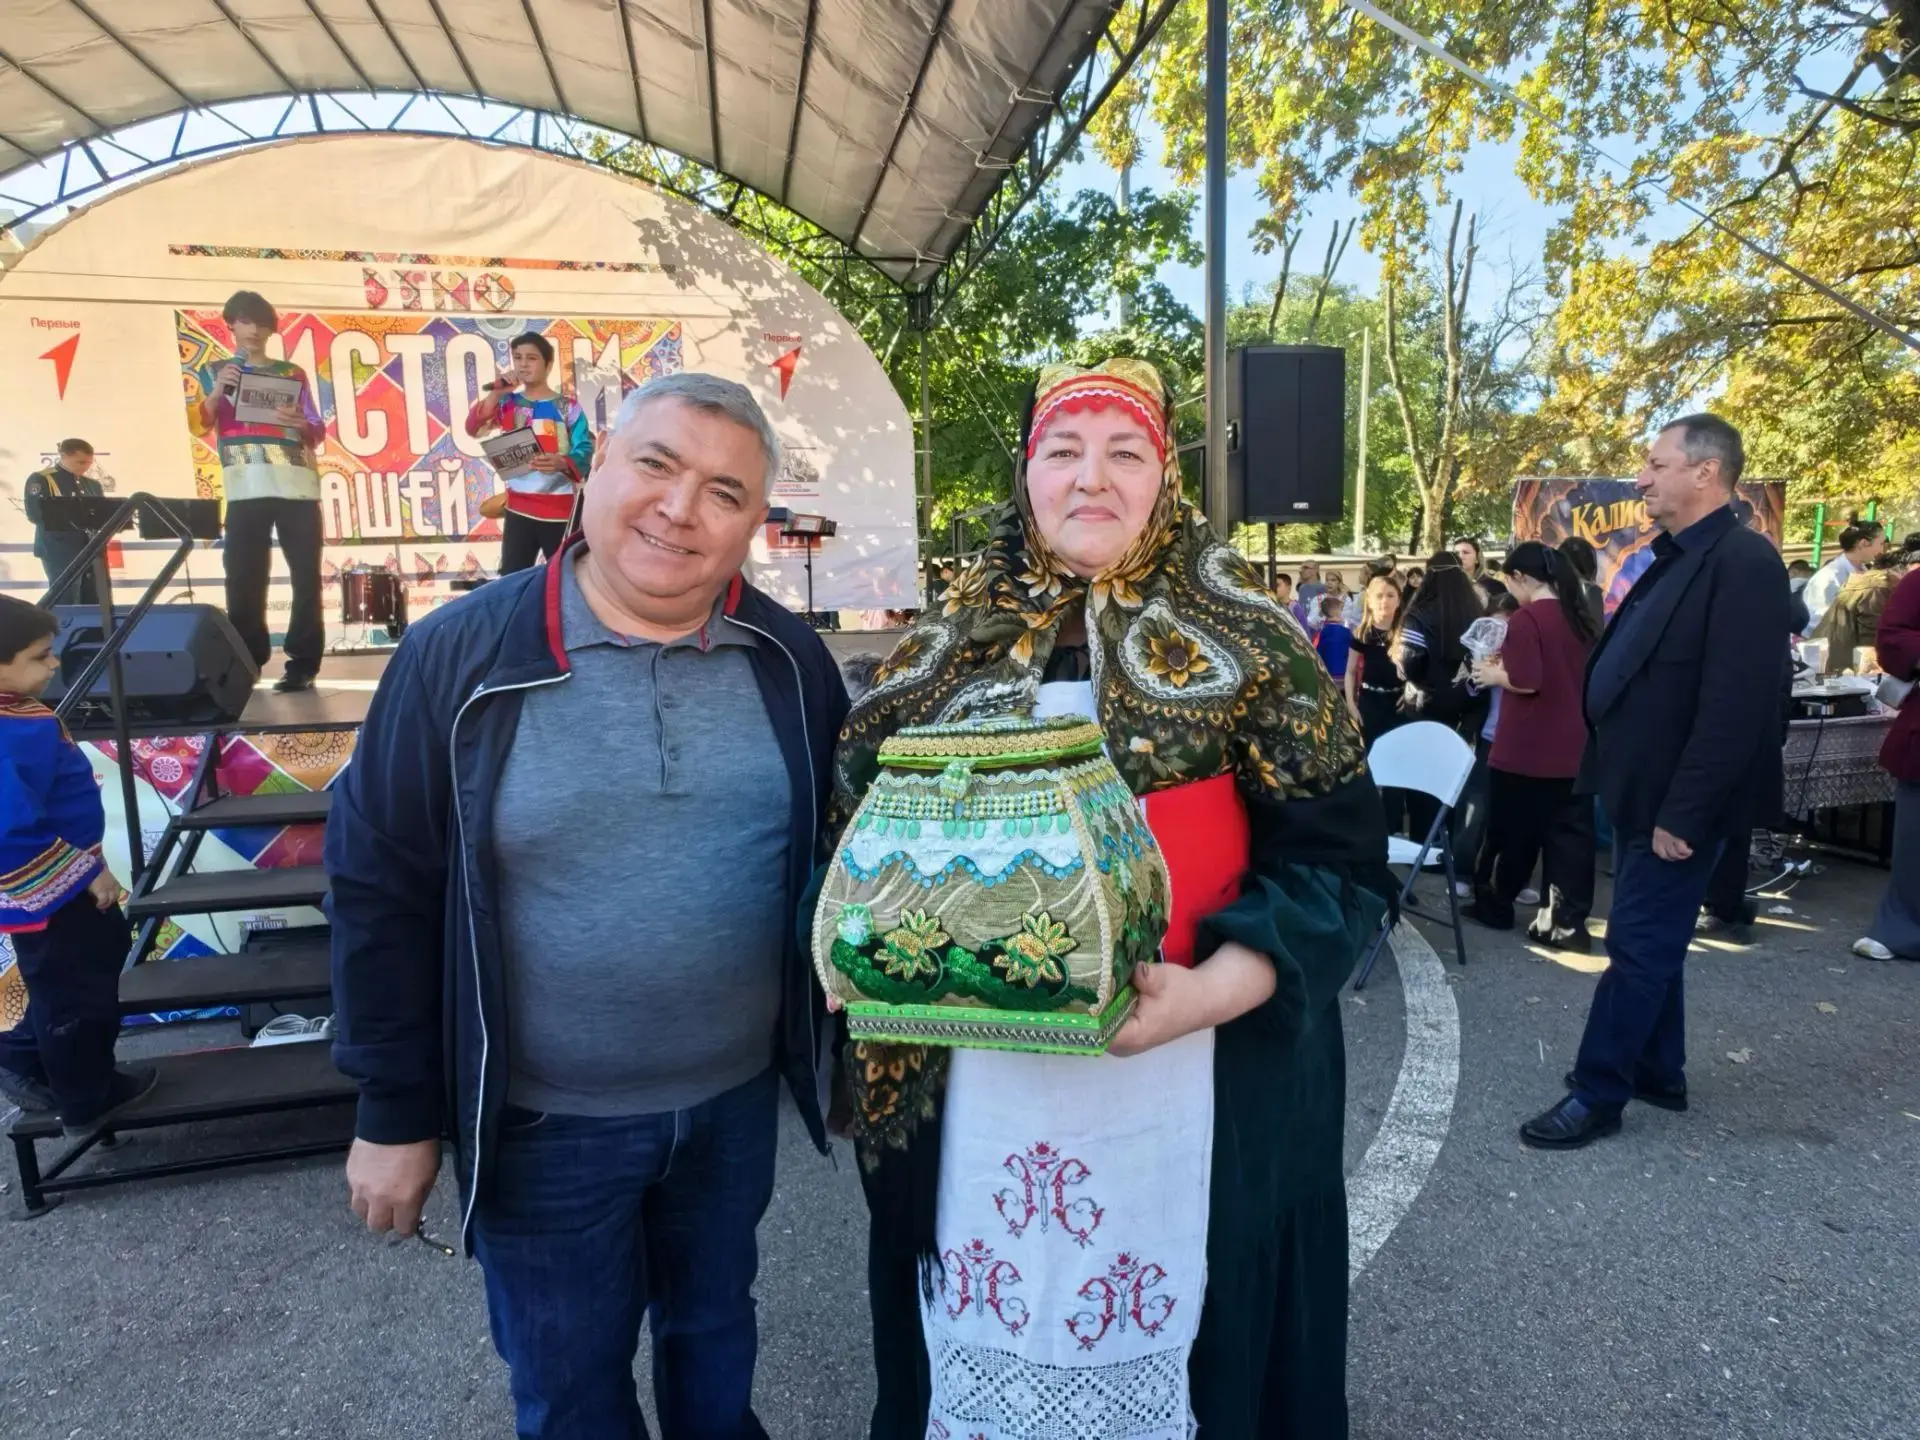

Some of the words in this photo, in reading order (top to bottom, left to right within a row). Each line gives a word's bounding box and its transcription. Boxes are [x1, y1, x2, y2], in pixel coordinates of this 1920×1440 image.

[30, 316, 81, 331] Первые
[763, 332, 802, 344] Первые
[264, 327, 624, 458] ИСТОИ
[320, 458, 470, 538] АШЕЙ
